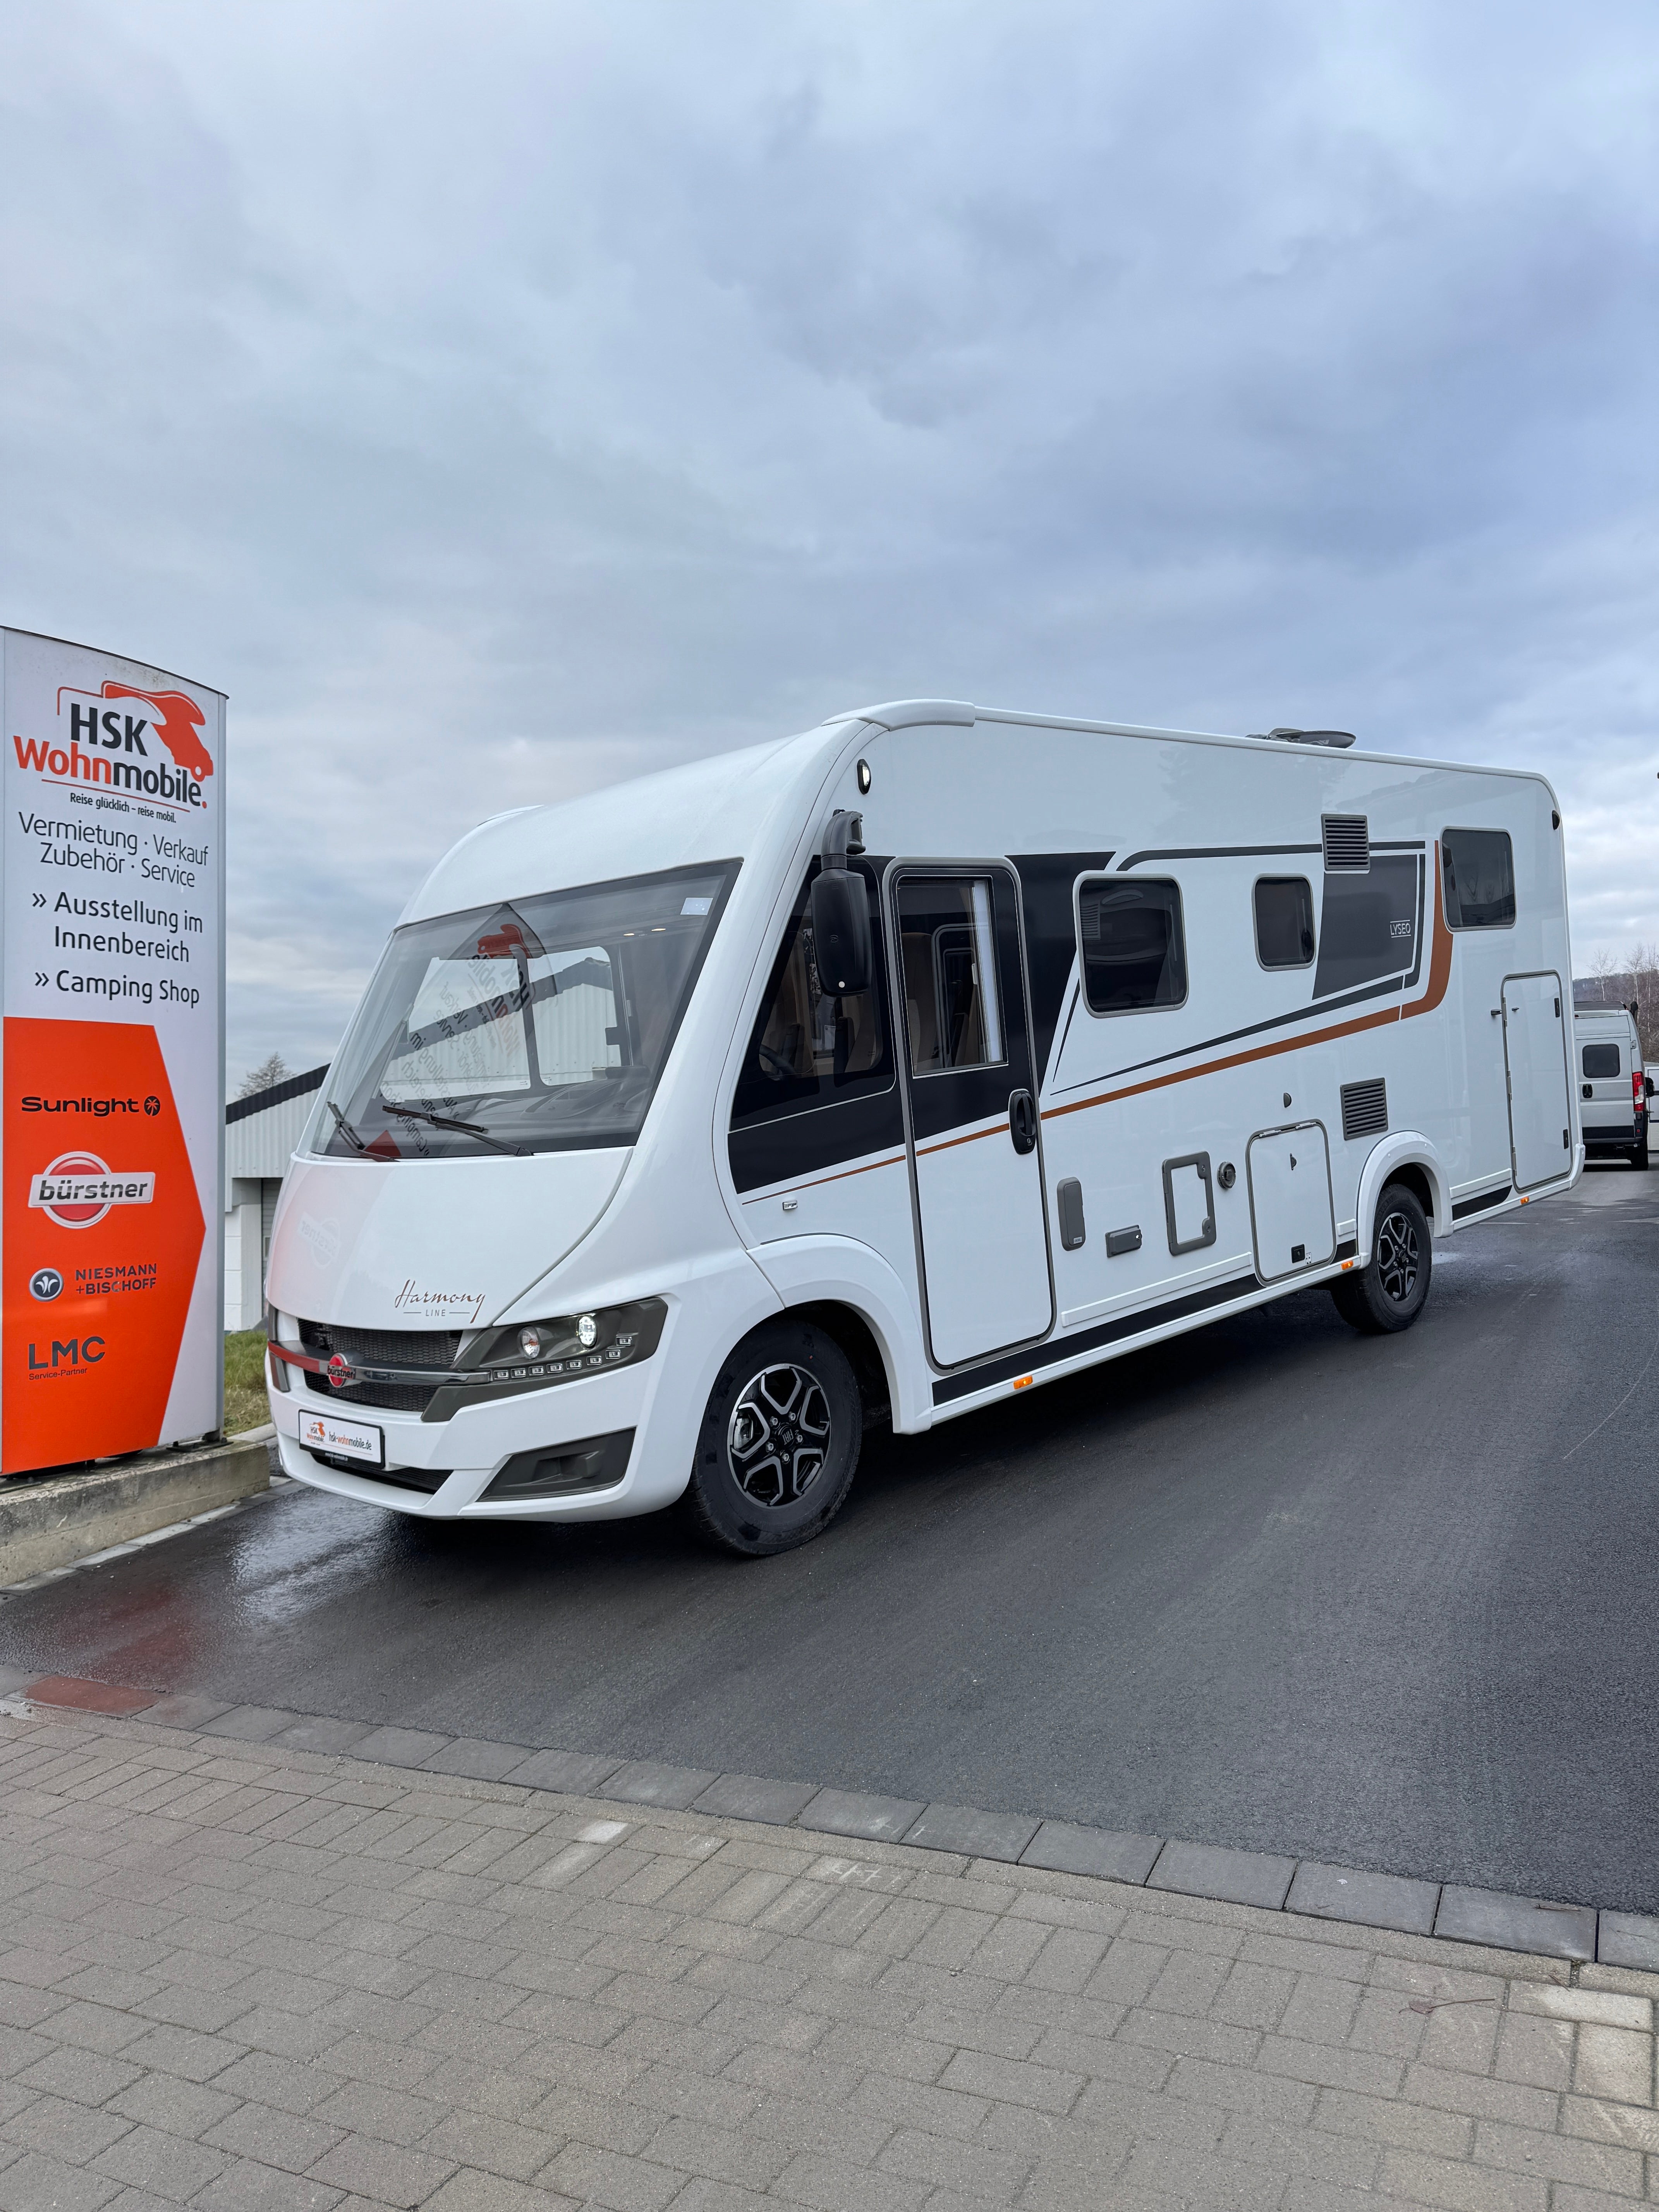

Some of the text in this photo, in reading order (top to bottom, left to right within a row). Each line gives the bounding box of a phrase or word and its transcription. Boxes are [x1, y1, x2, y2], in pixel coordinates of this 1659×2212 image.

[71, 703, 148, 757] HSK
[13, 735, 207, 809] Wohnmobile.
[70, 792, 176, 823] Reise glücklich reise mobil.
[18, 811, 208, 866] Vermietung Verkauf
[40, 842, 195, 887] Zubehör Service
[54, 891, 203, 933] Ausstellung im
[55, 926, 189, 962] Innenbereich
[1390, 923, 1411, 935] LYSEO
[56, 970, 199, 1008] Camping Shop
[21, 1096, 139, 1116] Sunlight
[39, 1180, 148, 1200] bürstner
[76, 1263, 157, 1281] NIESMANN
[76, 1278, 156, 1295] +BISCHOFF
[394, 1279, 486, 1324] Harmony
[29, 1336, 105, 1370] LMC
[29, 1367, 88, 1380] Service-Partner
[328, 1365, 353, 1378] bürstner
[329, 1431, 372, 1450] hsk-wohnmobile.de
[782, 1429, 793, 1445] FIAT
